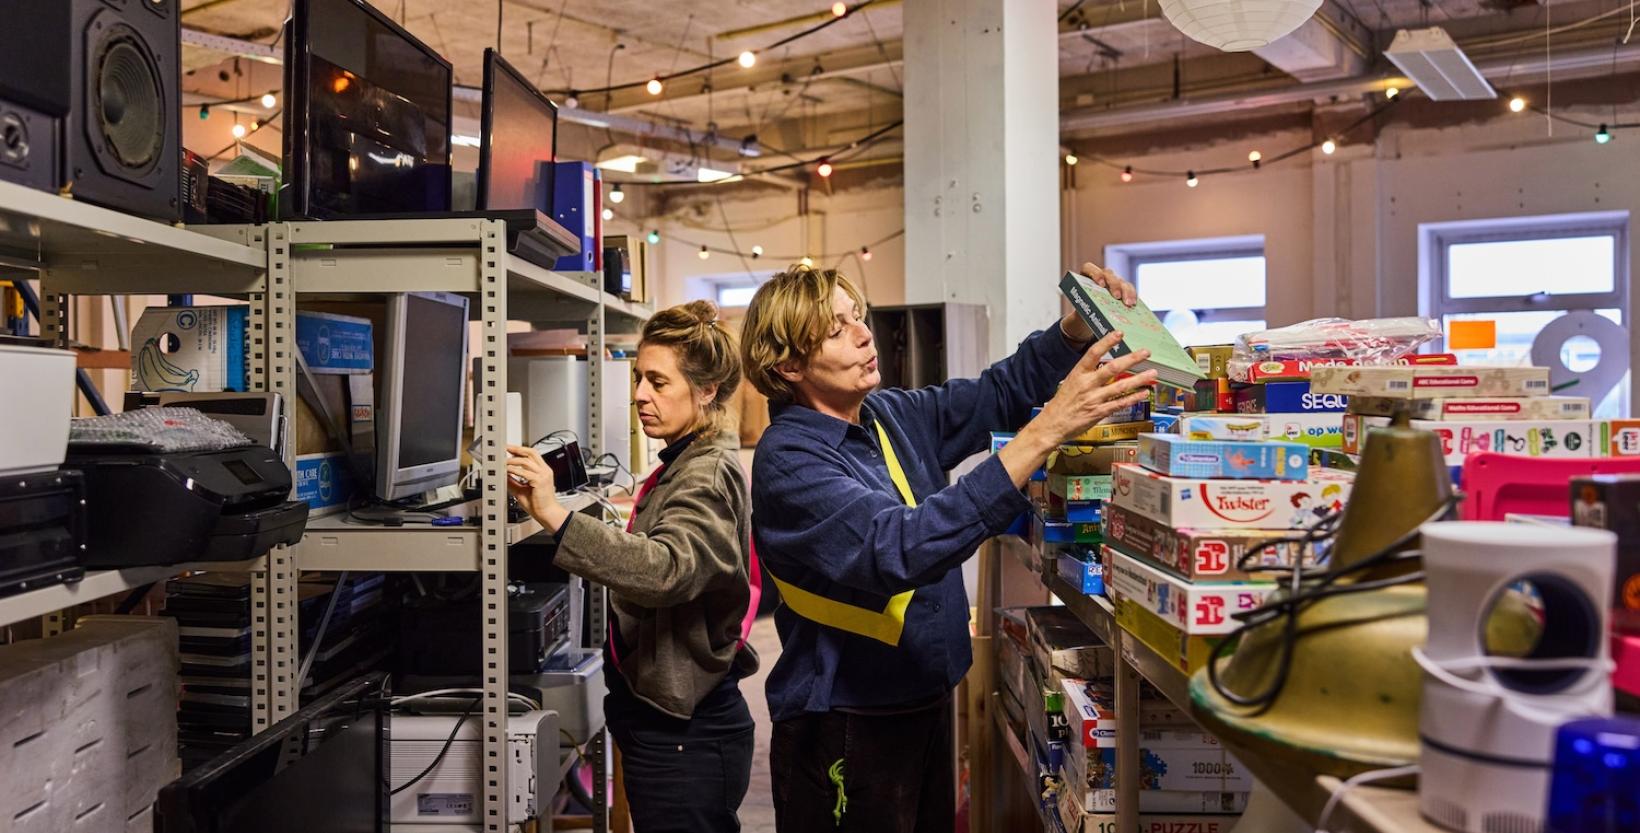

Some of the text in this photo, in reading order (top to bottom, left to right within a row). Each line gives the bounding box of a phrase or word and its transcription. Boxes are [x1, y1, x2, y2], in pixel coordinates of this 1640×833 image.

[1069, 285, 1093, 315] Magnetic
[1307, 427, 1324, 437] op
[1216, 496, 1270, 510] Twister
[1192, 760, 1221, 775] 1000
